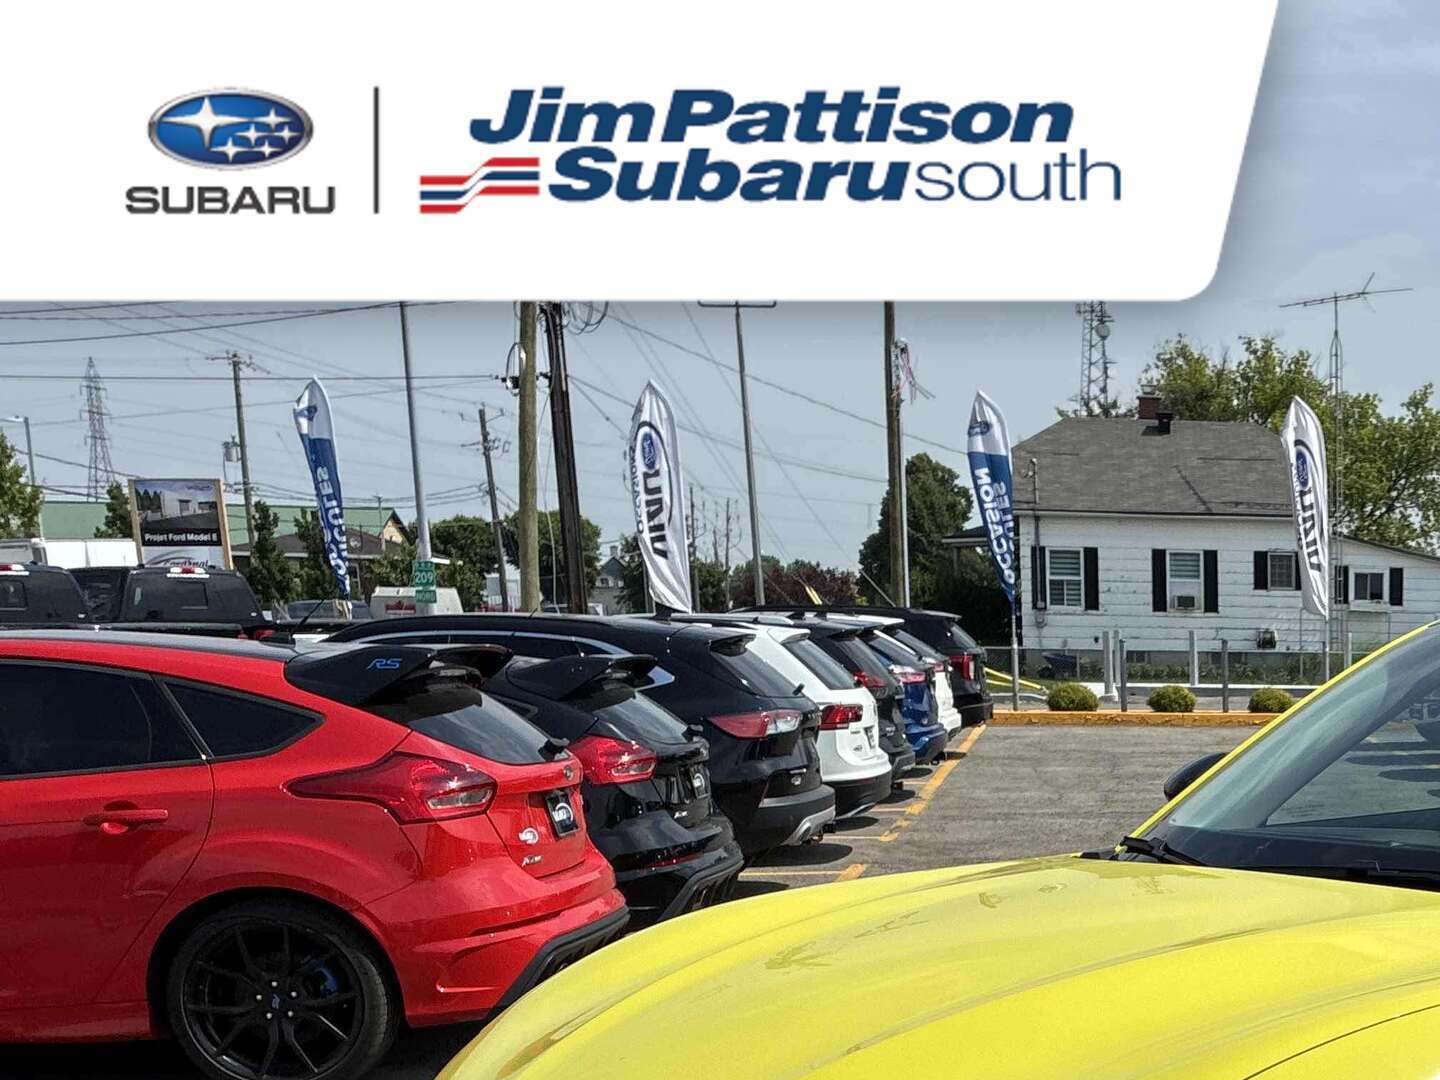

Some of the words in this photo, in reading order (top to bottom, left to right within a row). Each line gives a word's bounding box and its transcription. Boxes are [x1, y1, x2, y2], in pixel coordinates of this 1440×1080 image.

[168, 533, 186, 541] Ford
[187, 533, 211, 541] Model
[415, 571, 434, 584] 209
[366, 658, 402, 669] RS
